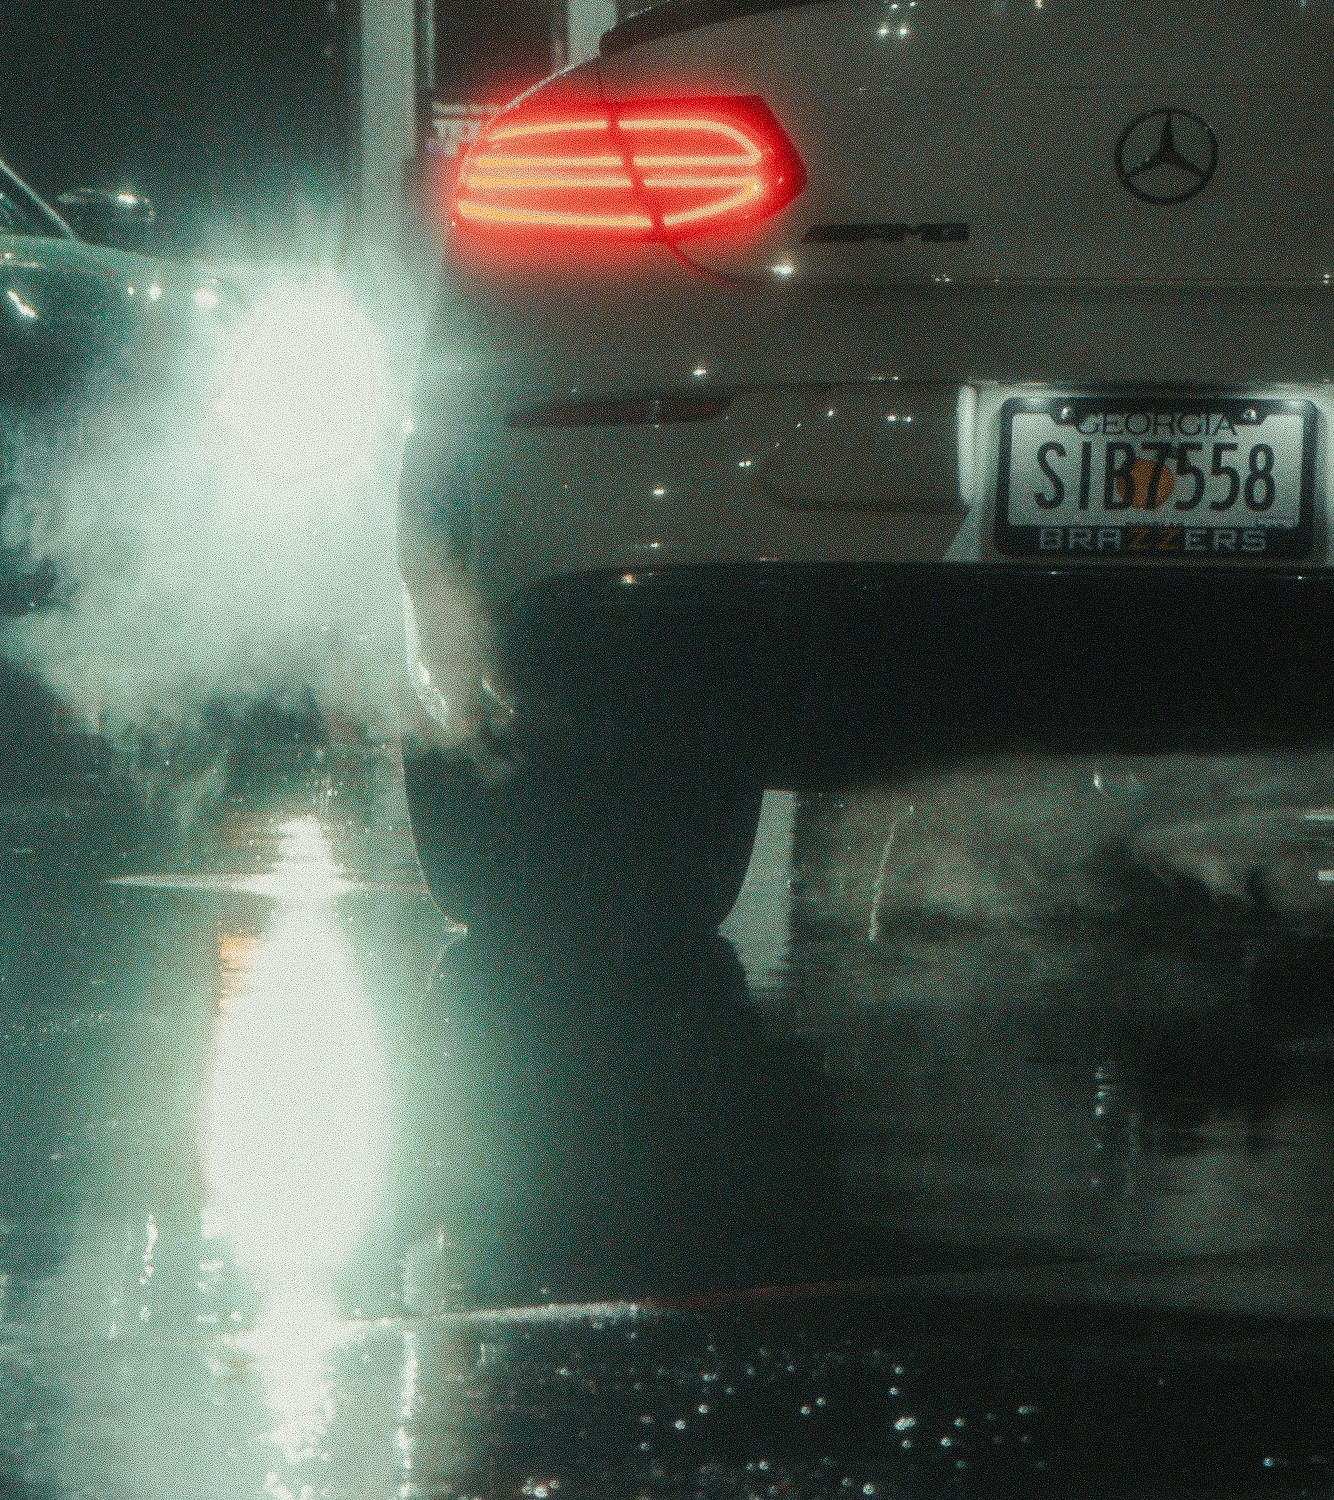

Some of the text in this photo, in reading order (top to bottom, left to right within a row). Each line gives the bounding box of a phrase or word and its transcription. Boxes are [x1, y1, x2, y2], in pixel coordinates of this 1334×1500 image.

[1075, 412, 1238, 437] GEORGIA
[1034, 441, 1276, 511] SIB7558
[1038, 527, 1267, 553] BRAZZERS
